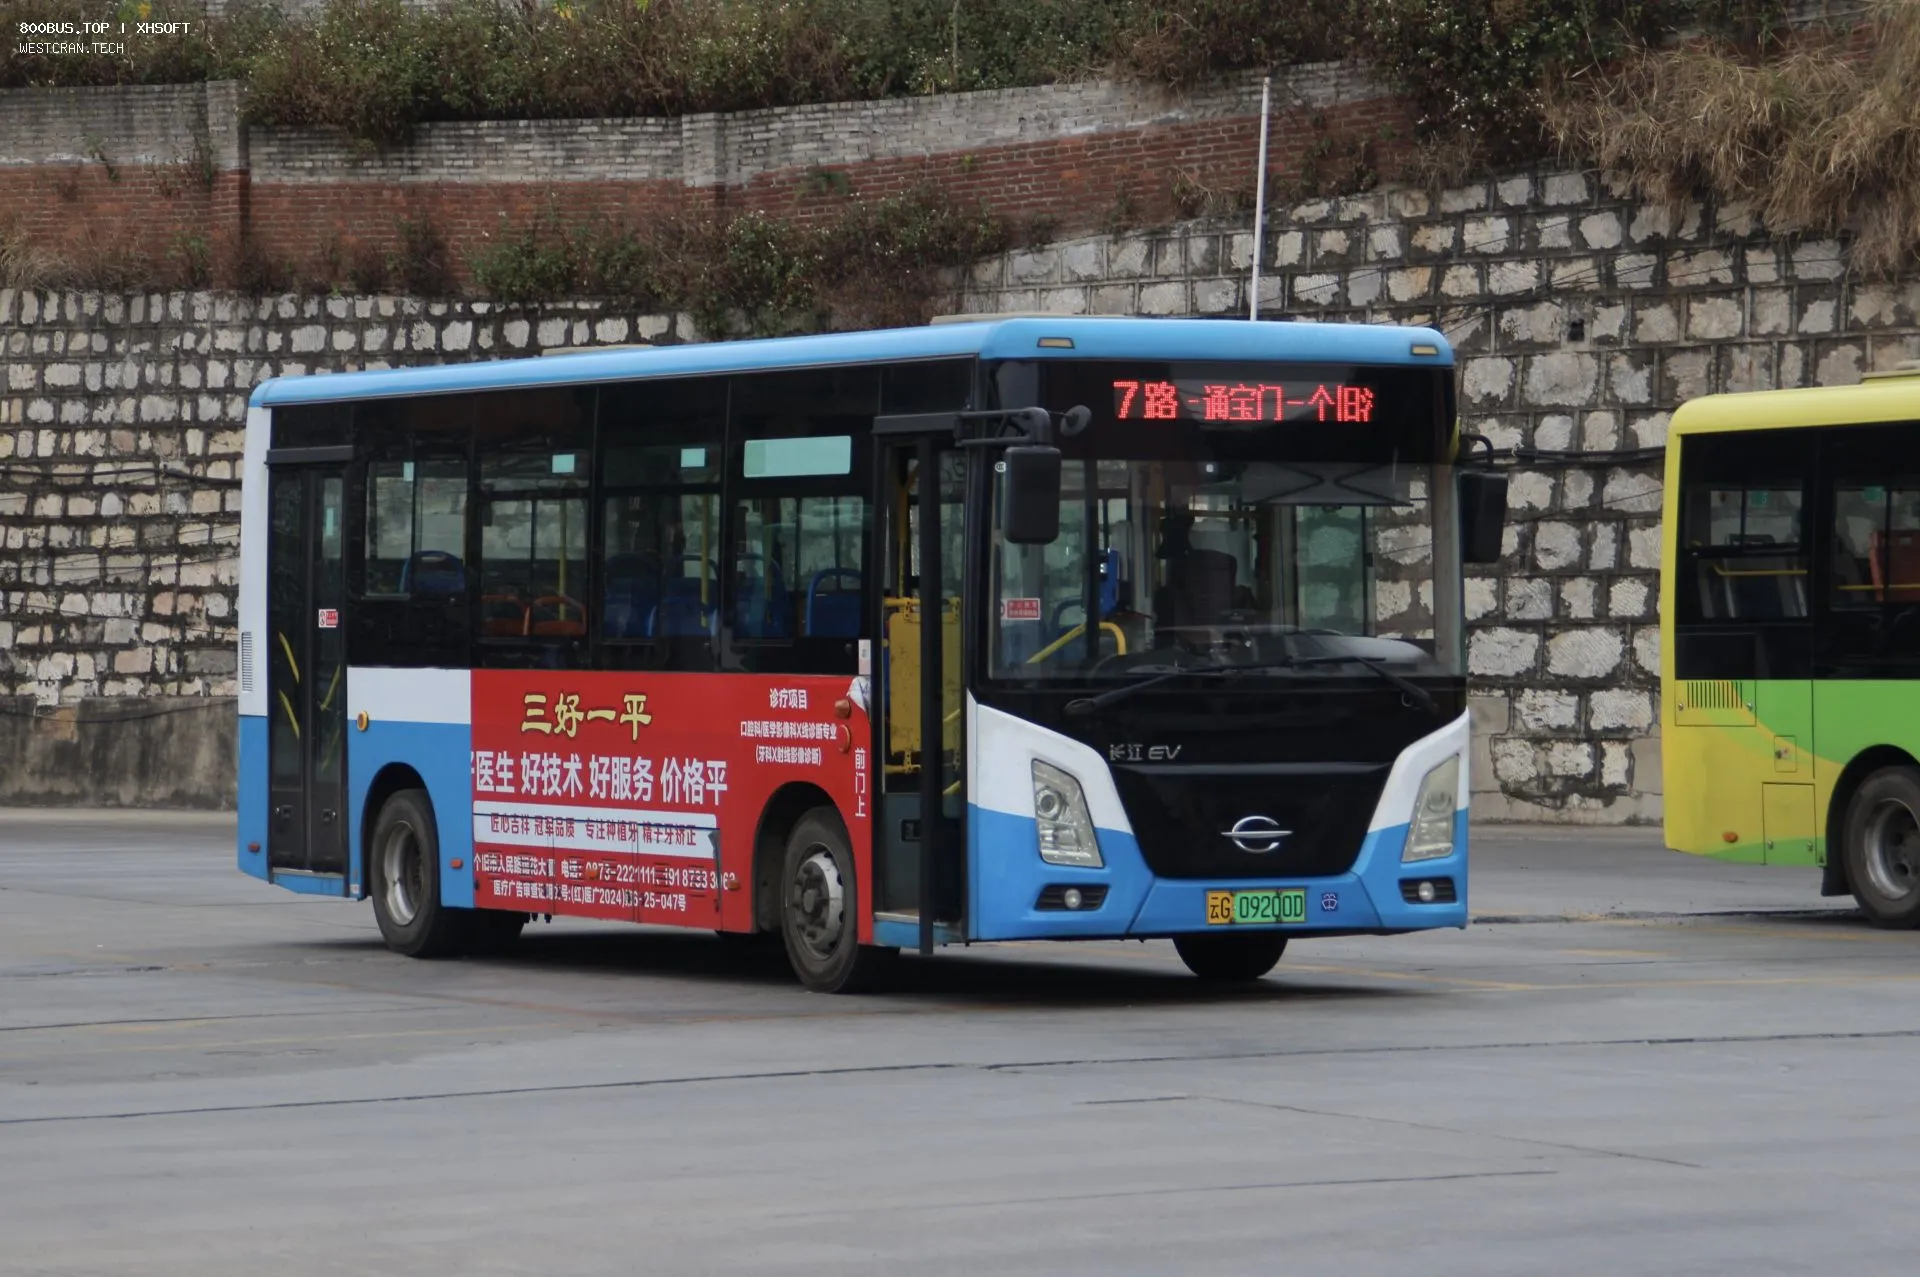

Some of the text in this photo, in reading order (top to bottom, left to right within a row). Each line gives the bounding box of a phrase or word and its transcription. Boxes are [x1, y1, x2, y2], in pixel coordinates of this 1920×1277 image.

[1113, 381, 1177, 419] 7路
[769, 688, 807, 709] 诊疗项目
[521, 693, 652, 741] 三好一平
[1109, 744, 1182, 761] 长江 EV
[470, 751, 728, 806] 医生 好技术 好服务 价格平
[855, 747, 866, 817] 前门上
[534, 815, 575, 838] 冠军品质
[585, 817, 638, 843] 专注种植牙
[1210, 894, 1304, 919] 云G 09200D
